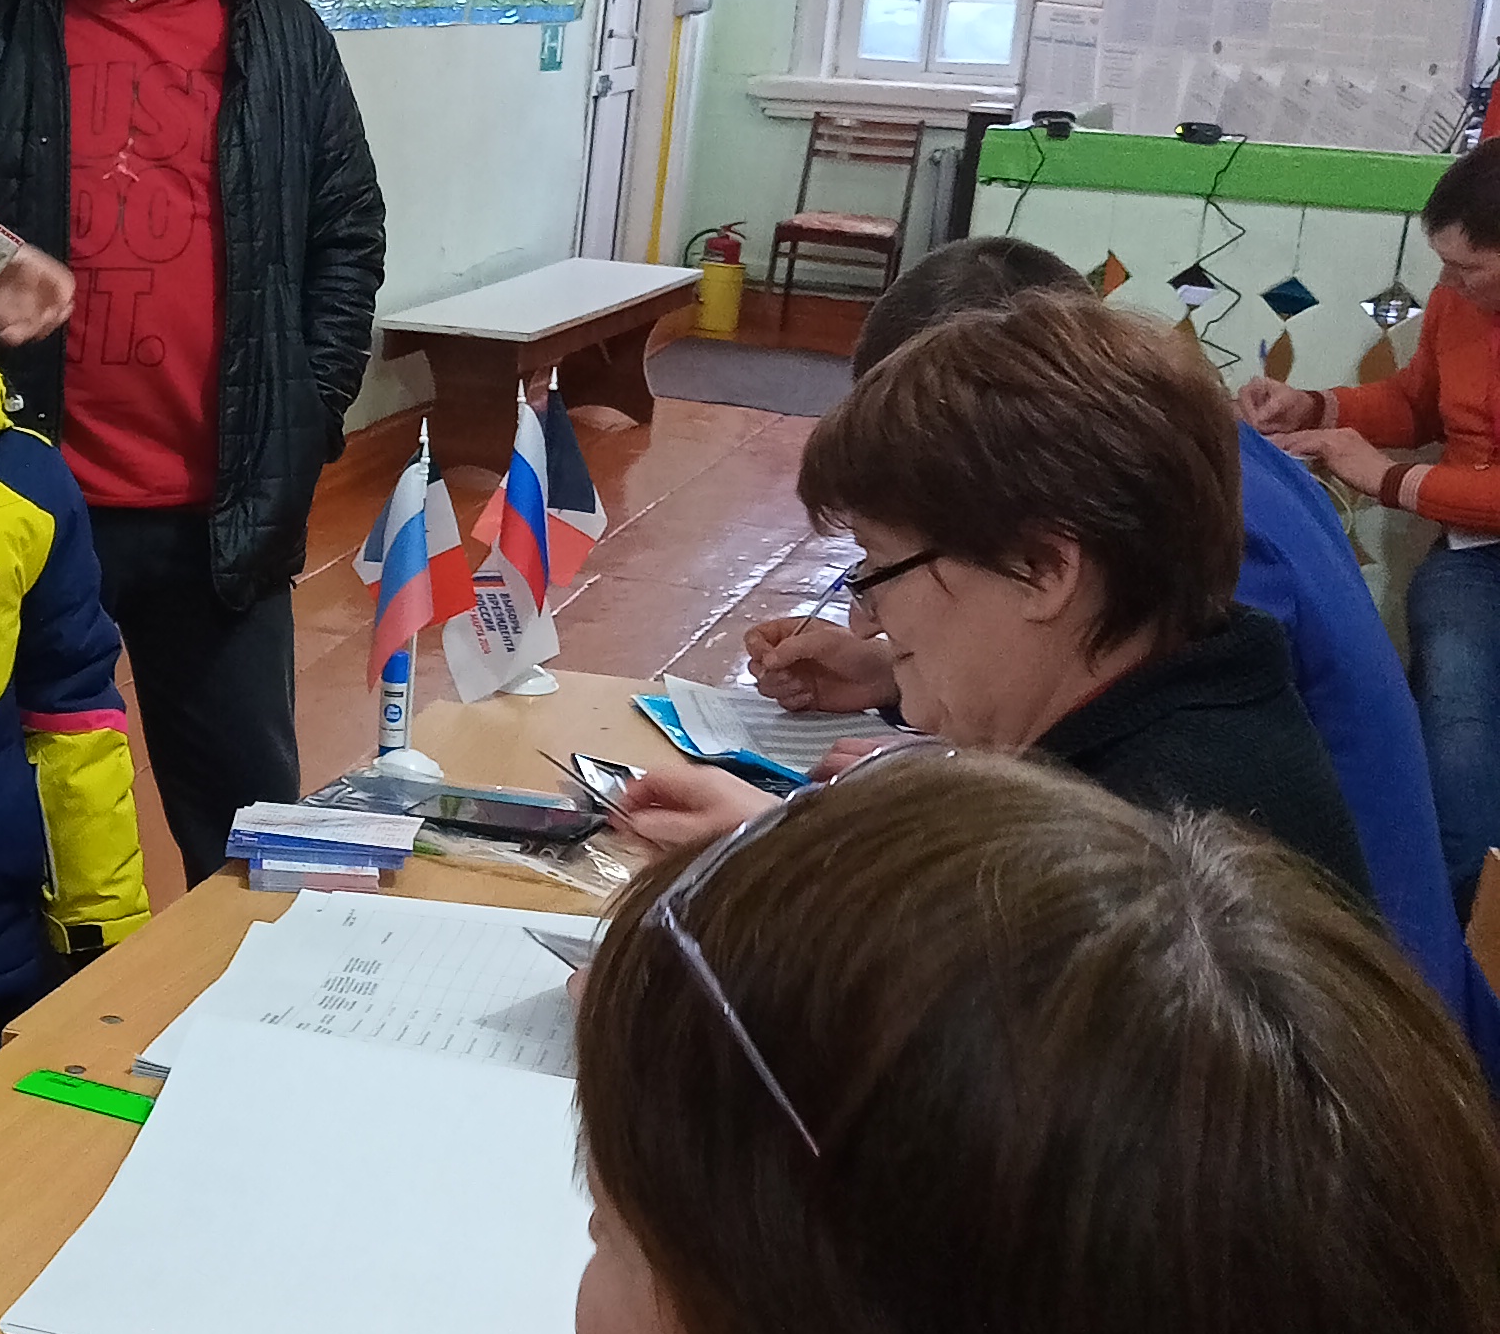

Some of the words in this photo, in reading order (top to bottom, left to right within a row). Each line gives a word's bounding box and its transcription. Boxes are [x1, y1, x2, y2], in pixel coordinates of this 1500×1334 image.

[475, 593, 497, 632] РОССИИ
[486, 592, 516, 653] ПРЕЗИДЕНТА
[499, 592, 522, 635] ВЫБОРЫ
